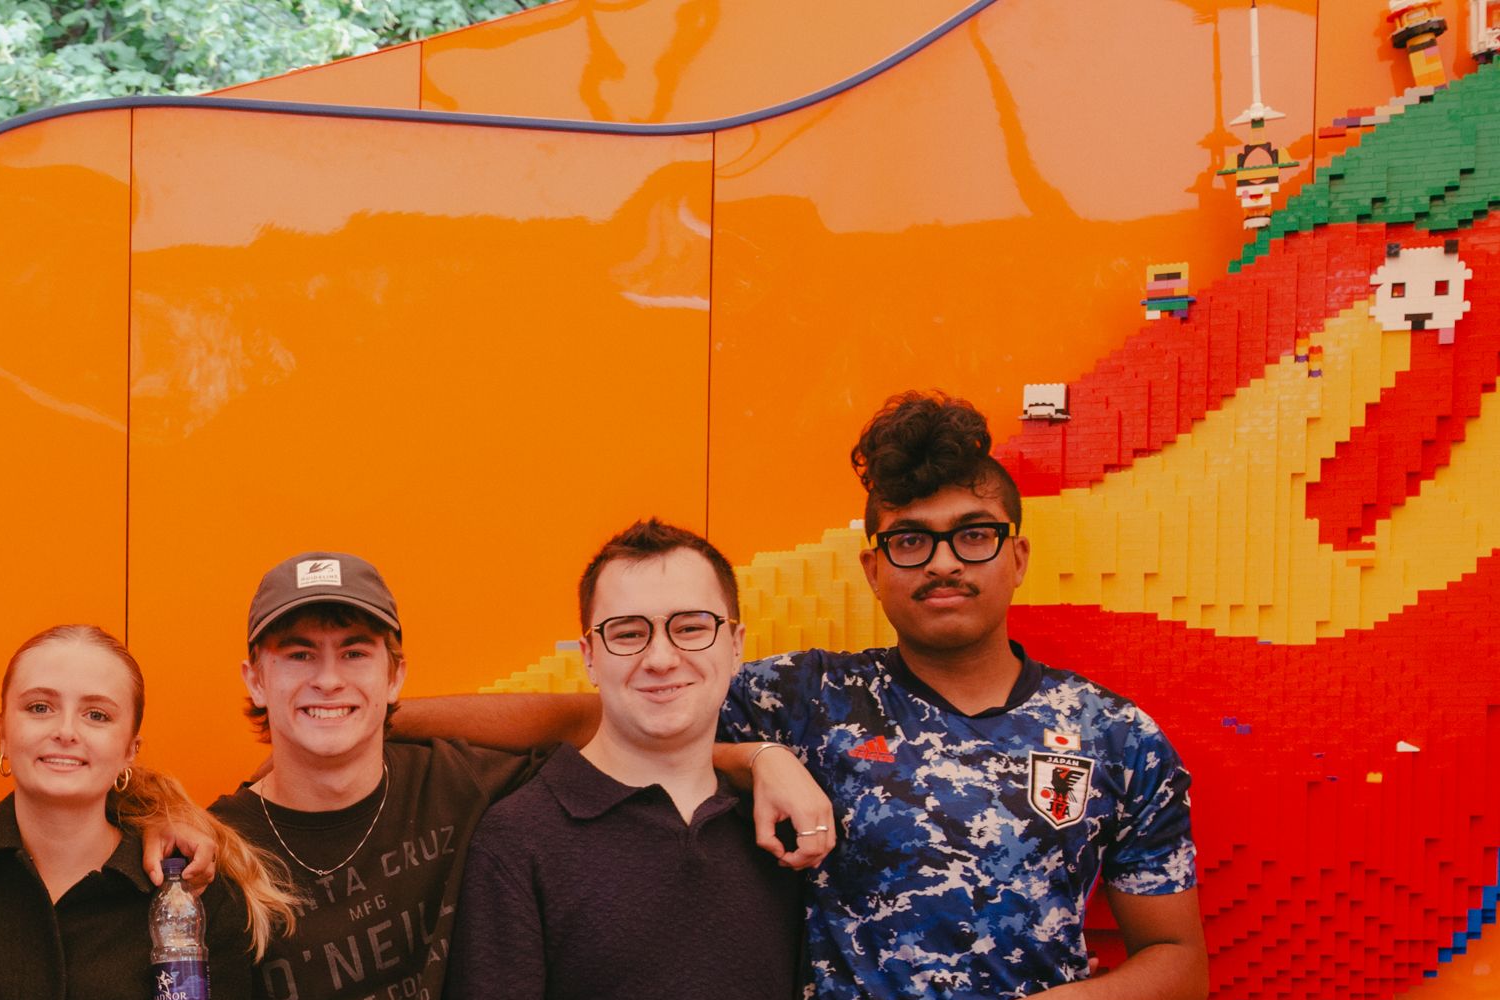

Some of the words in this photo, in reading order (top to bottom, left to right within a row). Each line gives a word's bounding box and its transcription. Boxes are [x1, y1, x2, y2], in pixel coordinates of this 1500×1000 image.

[1046, 757, 1080, 767] JAPAN
[1046, 801, 1071, 817] JFA
[380, 825, 455, 878] CRUZ
